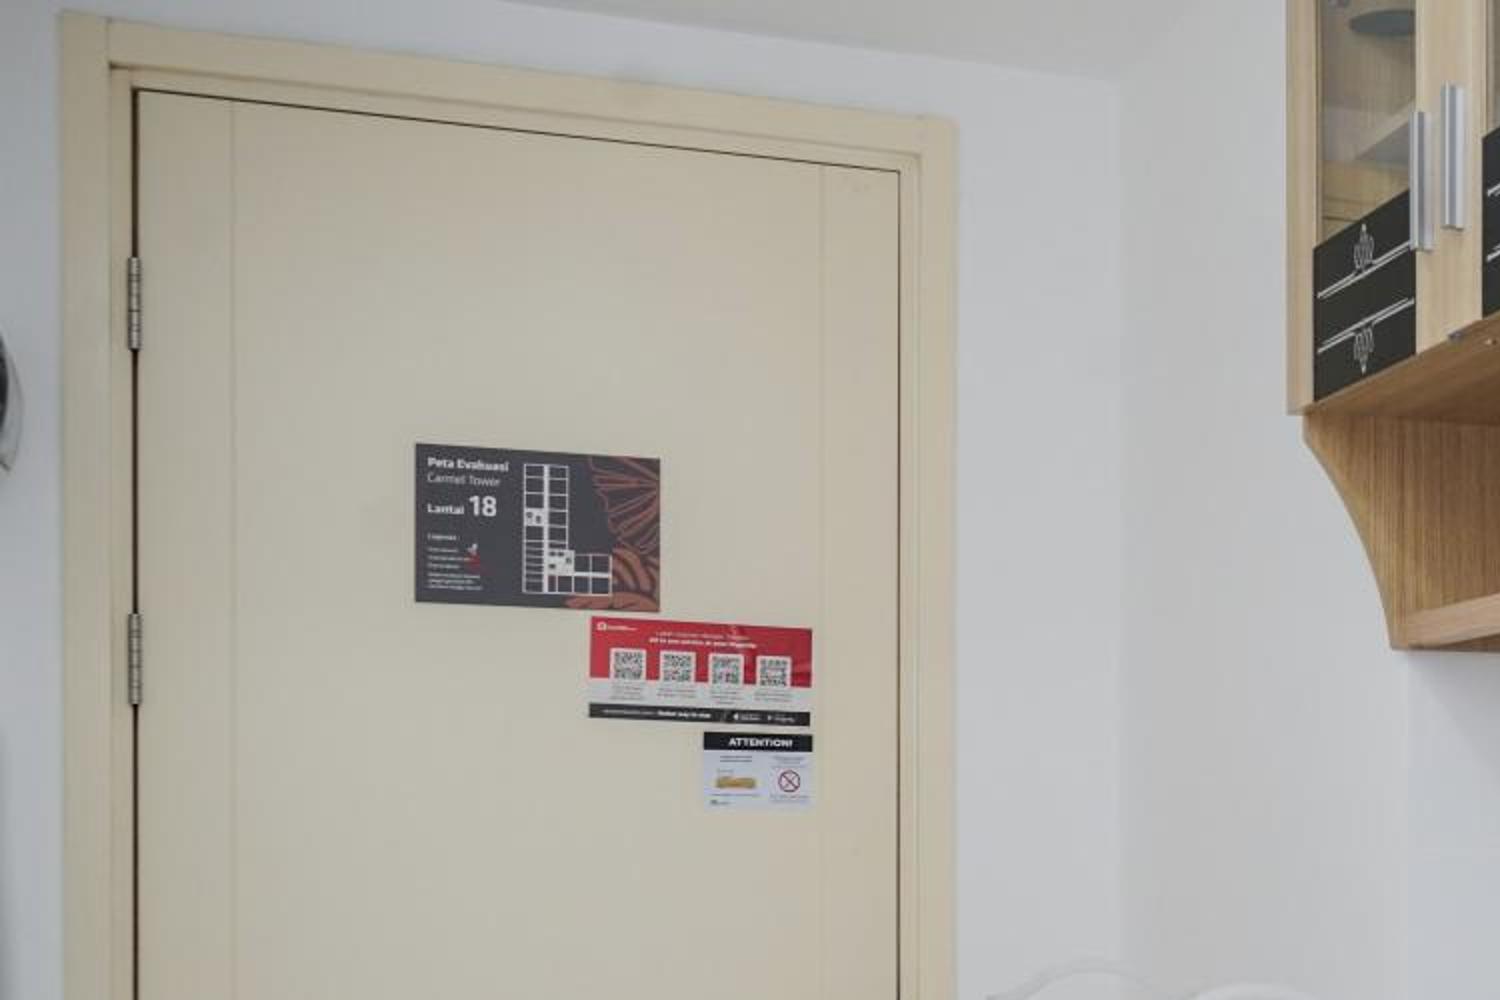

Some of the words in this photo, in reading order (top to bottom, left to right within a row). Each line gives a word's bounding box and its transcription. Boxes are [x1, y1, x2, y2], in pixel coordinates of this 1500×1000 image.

[427, 456, 454, 468] Peta
[457, 458, 509, 471] Evakuasi
[469, 475, 500, 487] Tower
[426, 502, 464, 514] Lantai
[468, 495, 496, 517] 18
[728, 737, 793, 748] ATTENTION!
